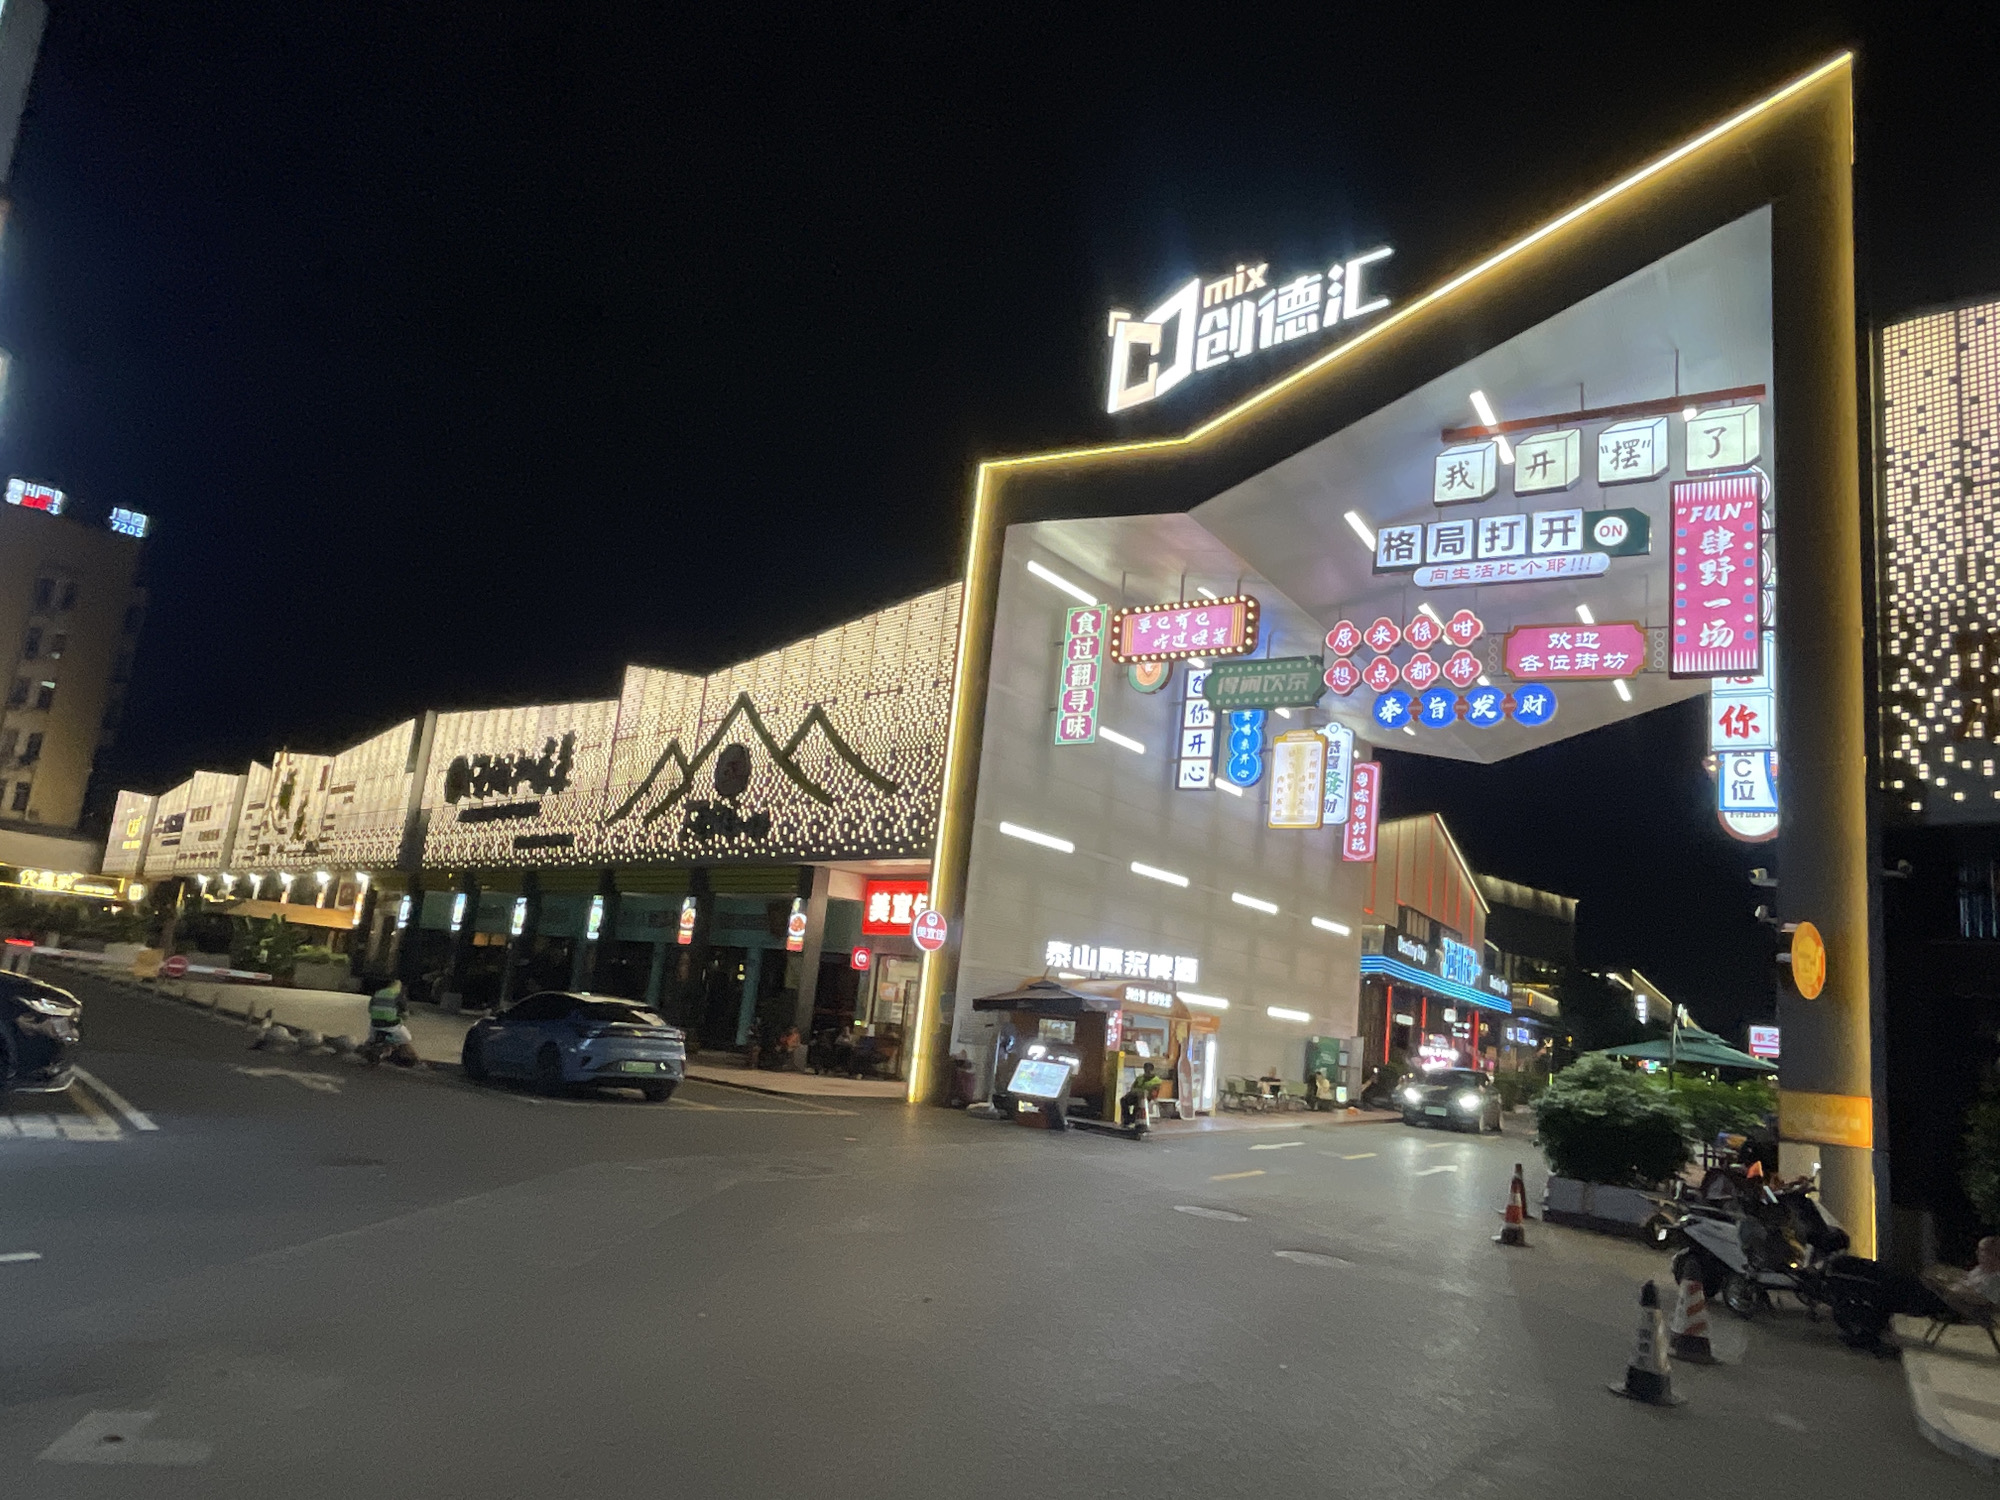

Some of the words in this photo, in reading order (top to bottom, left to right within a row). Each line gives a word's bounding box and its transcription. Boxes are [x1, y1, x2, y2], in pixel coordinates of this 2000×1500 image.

[1203, 262, 1269, 308] mix
[1196, 247, 1395, 371] 创德汇
[1383, 513, 1577, 563] 格局打开
[1599, 523, 1623, 538] ON
[1699, 525, 1736, 649] 肆野一场
[1518, 652, 1629, 672] 各位街坊
[1547, 631, 1601, 650] 欢迎
[1065, 611, 1097, 739] 食过翻寻味
[1332, 657, 1474, 687] 想点都得
[1378, 694, 1547, 724] 奉旨发财
[1731, 752, 1756, 801] C位
